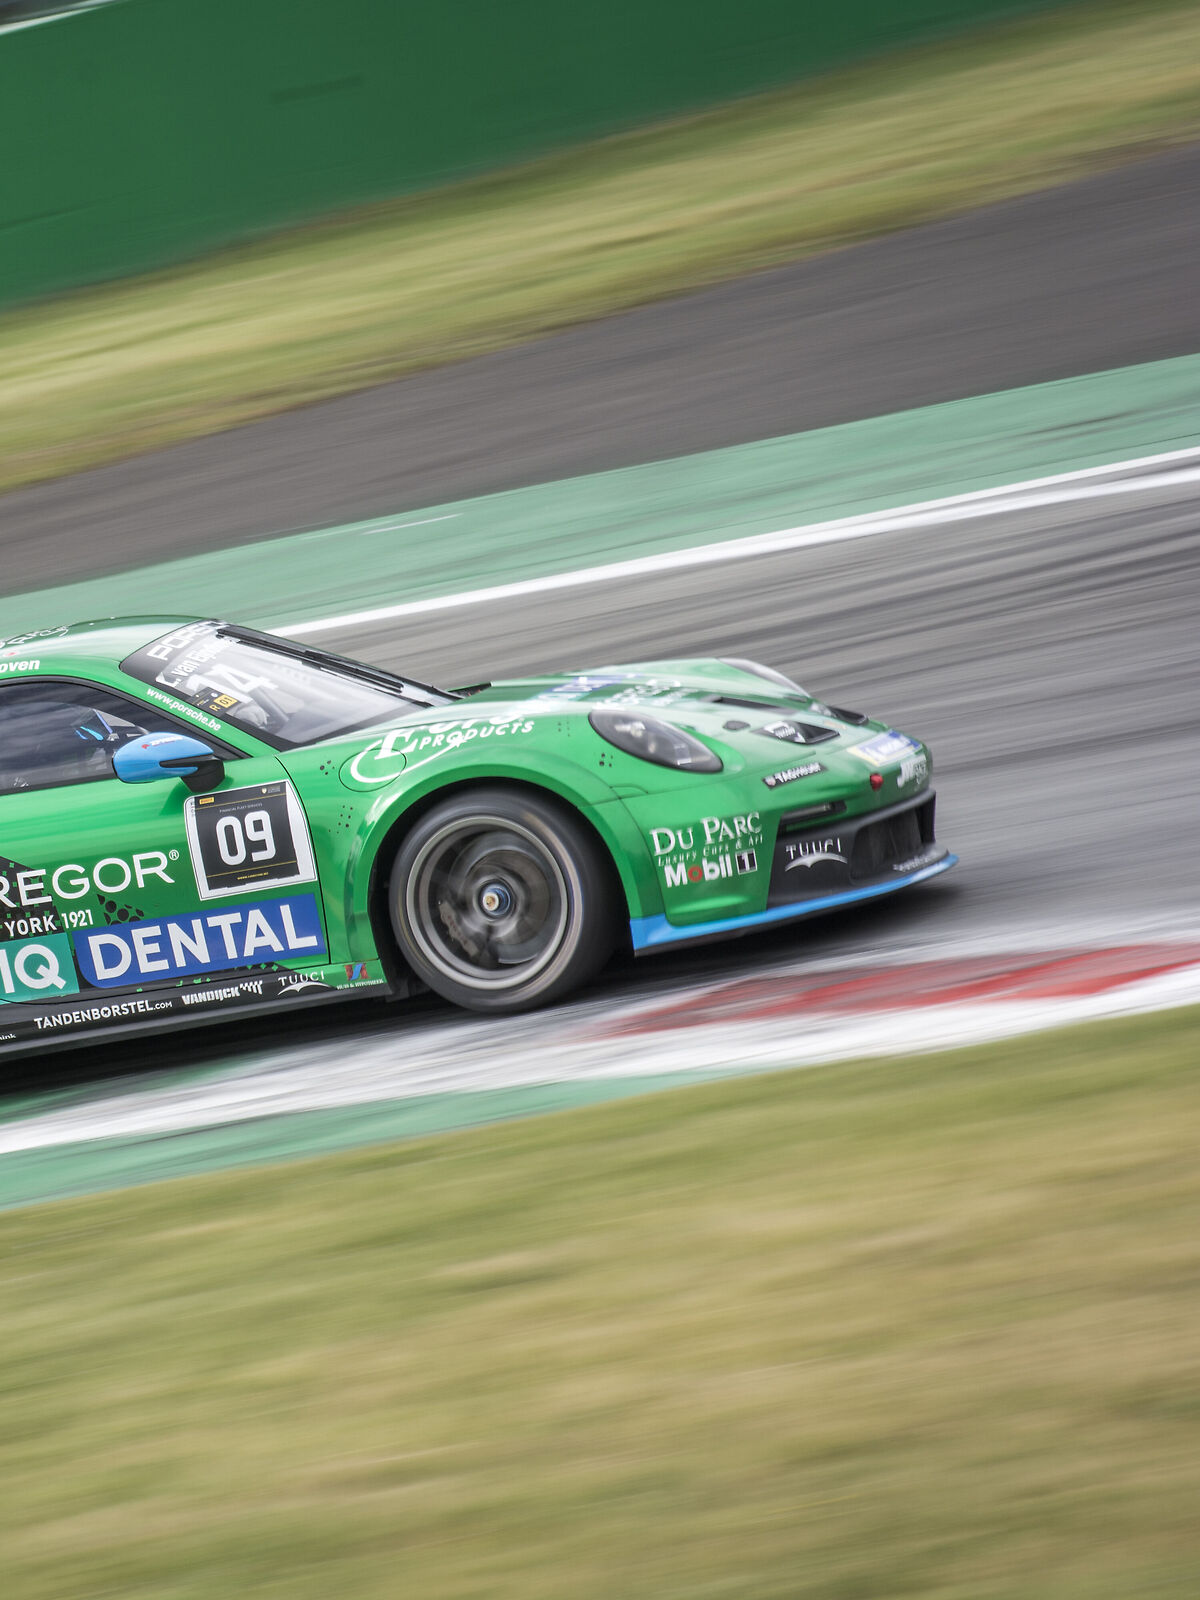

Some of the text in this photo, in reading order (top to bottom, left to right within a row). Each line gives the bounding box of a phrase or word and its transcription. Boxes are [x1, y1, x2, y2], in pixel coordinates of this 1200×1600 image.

[146, 688, 221, 731] www.porsche.be
[419, 721, 535, 750] PRODUCTS
[216, 810, 277, 866] 09
[785, 837, 842, 861] TUUCI
[664, 853, 733, 888] Mobil
[4, 915, 57, 937] YORK
[61, 909, 93, 930] 1921
[87, 904, 318, 981] DENTAL
[278, 970, 325, 987] TUUCI
